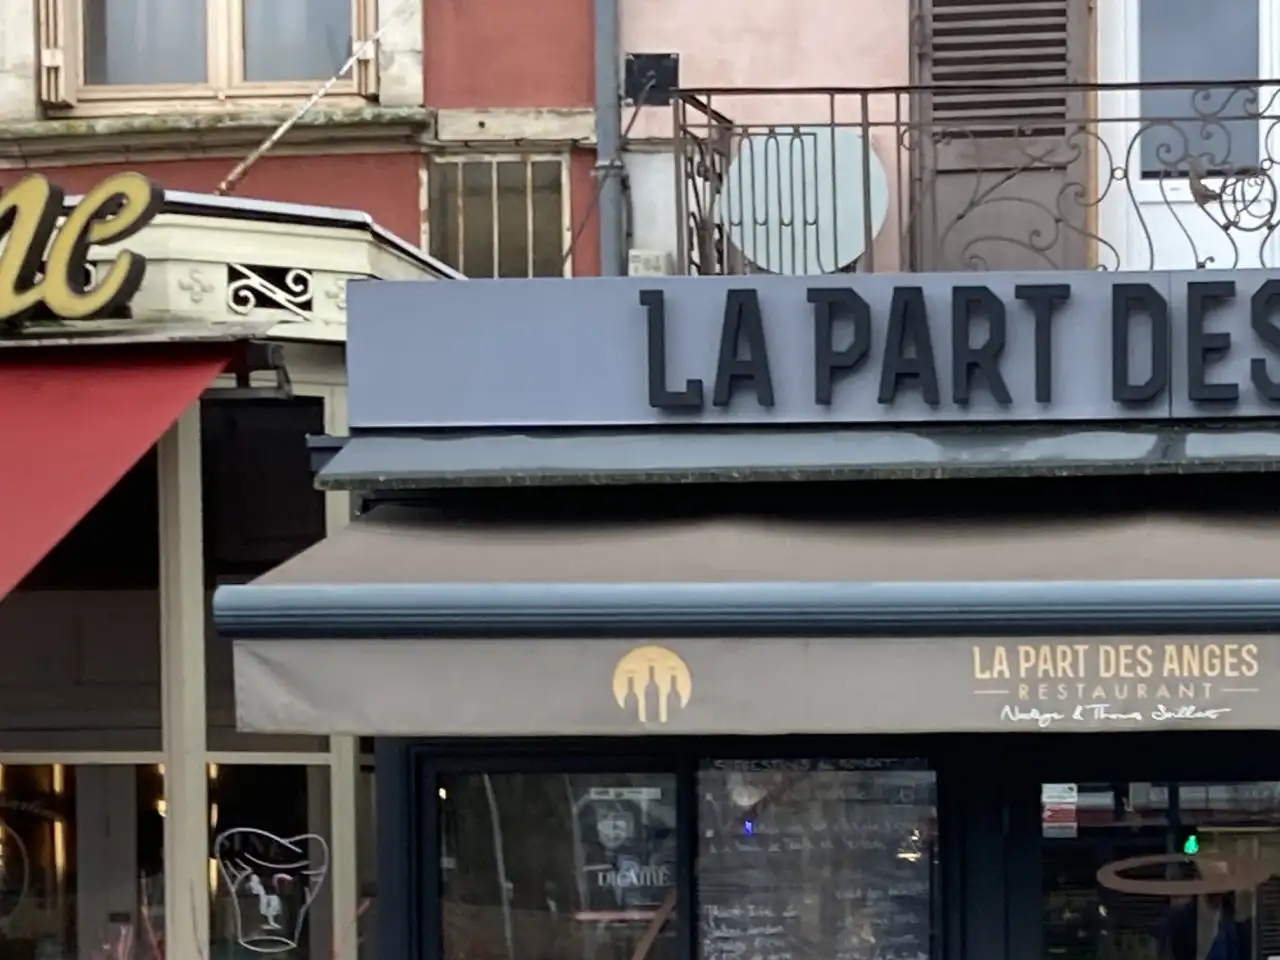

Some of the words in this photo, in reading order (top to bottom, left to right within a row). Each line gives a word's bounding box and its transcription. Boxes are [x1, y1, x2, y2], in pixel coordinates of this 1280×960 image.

[640, 288, 775, 409] LA
[807, 284, 1071, 405] PART
[973, 645, 1010, 679] LA
[1018, 644, 1089, 679] PART
[1099, 644, 1153, 678] DES
[1162, 643, 1260, 677] ANGES
[1017, 682, 1214, 700] RESTAURANT
